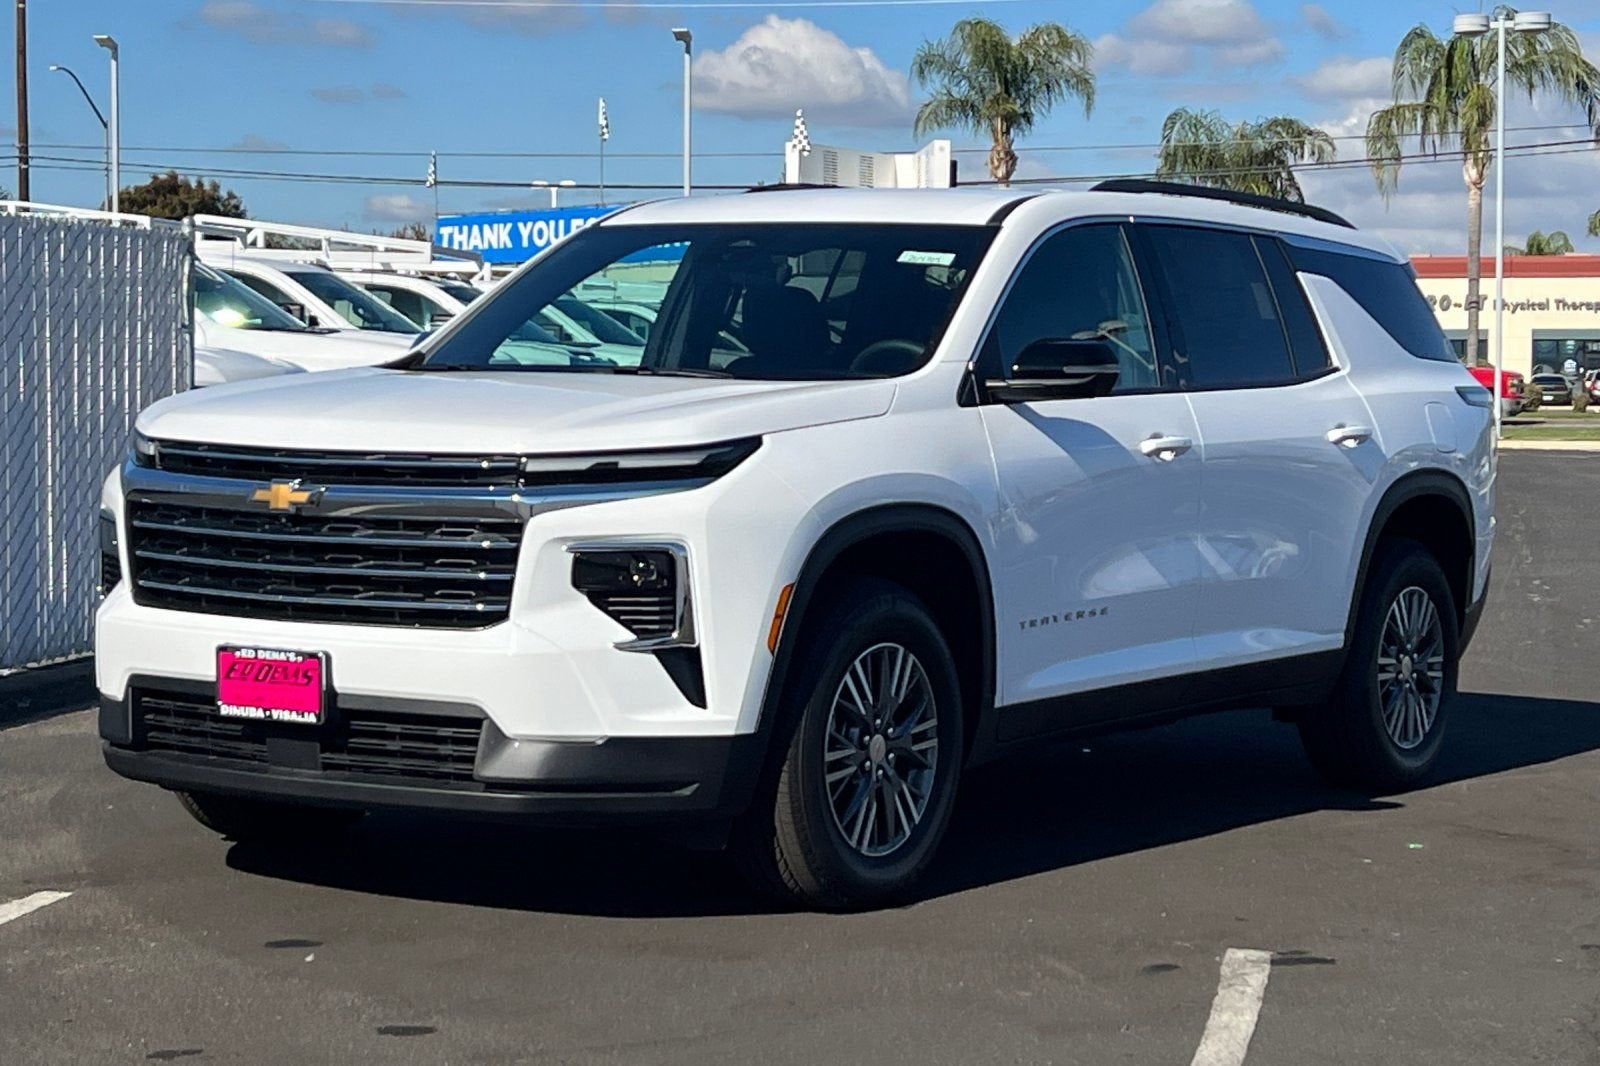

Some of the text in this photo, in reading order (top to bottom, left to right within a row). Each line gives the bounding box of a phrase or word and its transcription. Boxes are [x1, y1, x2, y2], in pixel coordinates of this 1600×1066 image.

[439, 222, 513, 250] THANK
[517, 219, 565, 248] YOU
[1019, 606, 1109, 630] TRAVERSE
[240, 648, 256, 659] ED
